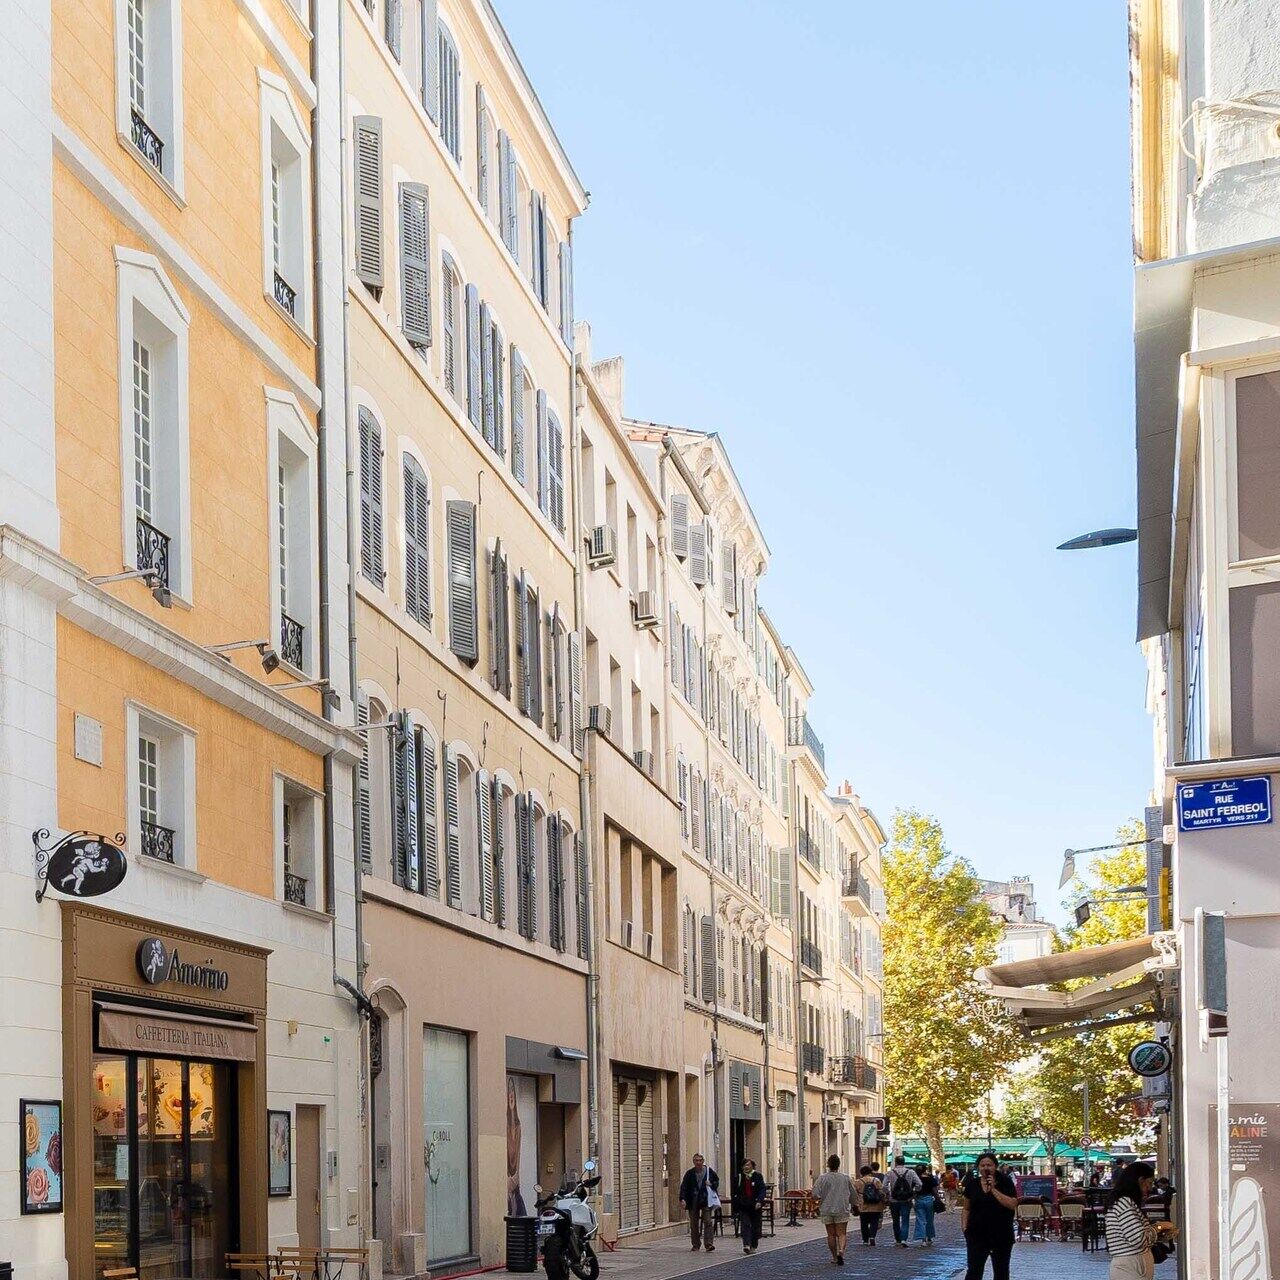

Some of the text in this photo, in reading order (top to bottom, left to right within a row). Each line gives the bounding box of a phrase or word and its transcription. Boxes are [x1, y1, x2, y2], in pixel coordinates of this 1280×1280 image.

[1215, 795, 1234, 804] RUE
[1184, 803, 1267, 819] SAINT FERREOL
[1193, 817, 1222, 826] MARTYR
[166, 948, 229, 991] Amorino
[135, 1024, 229, 1049] CAFFETTERIA ITALIANA
[1238, 1113, 1268, 1125] mie
[1230, 1127, 1268, 1138] ALINE
